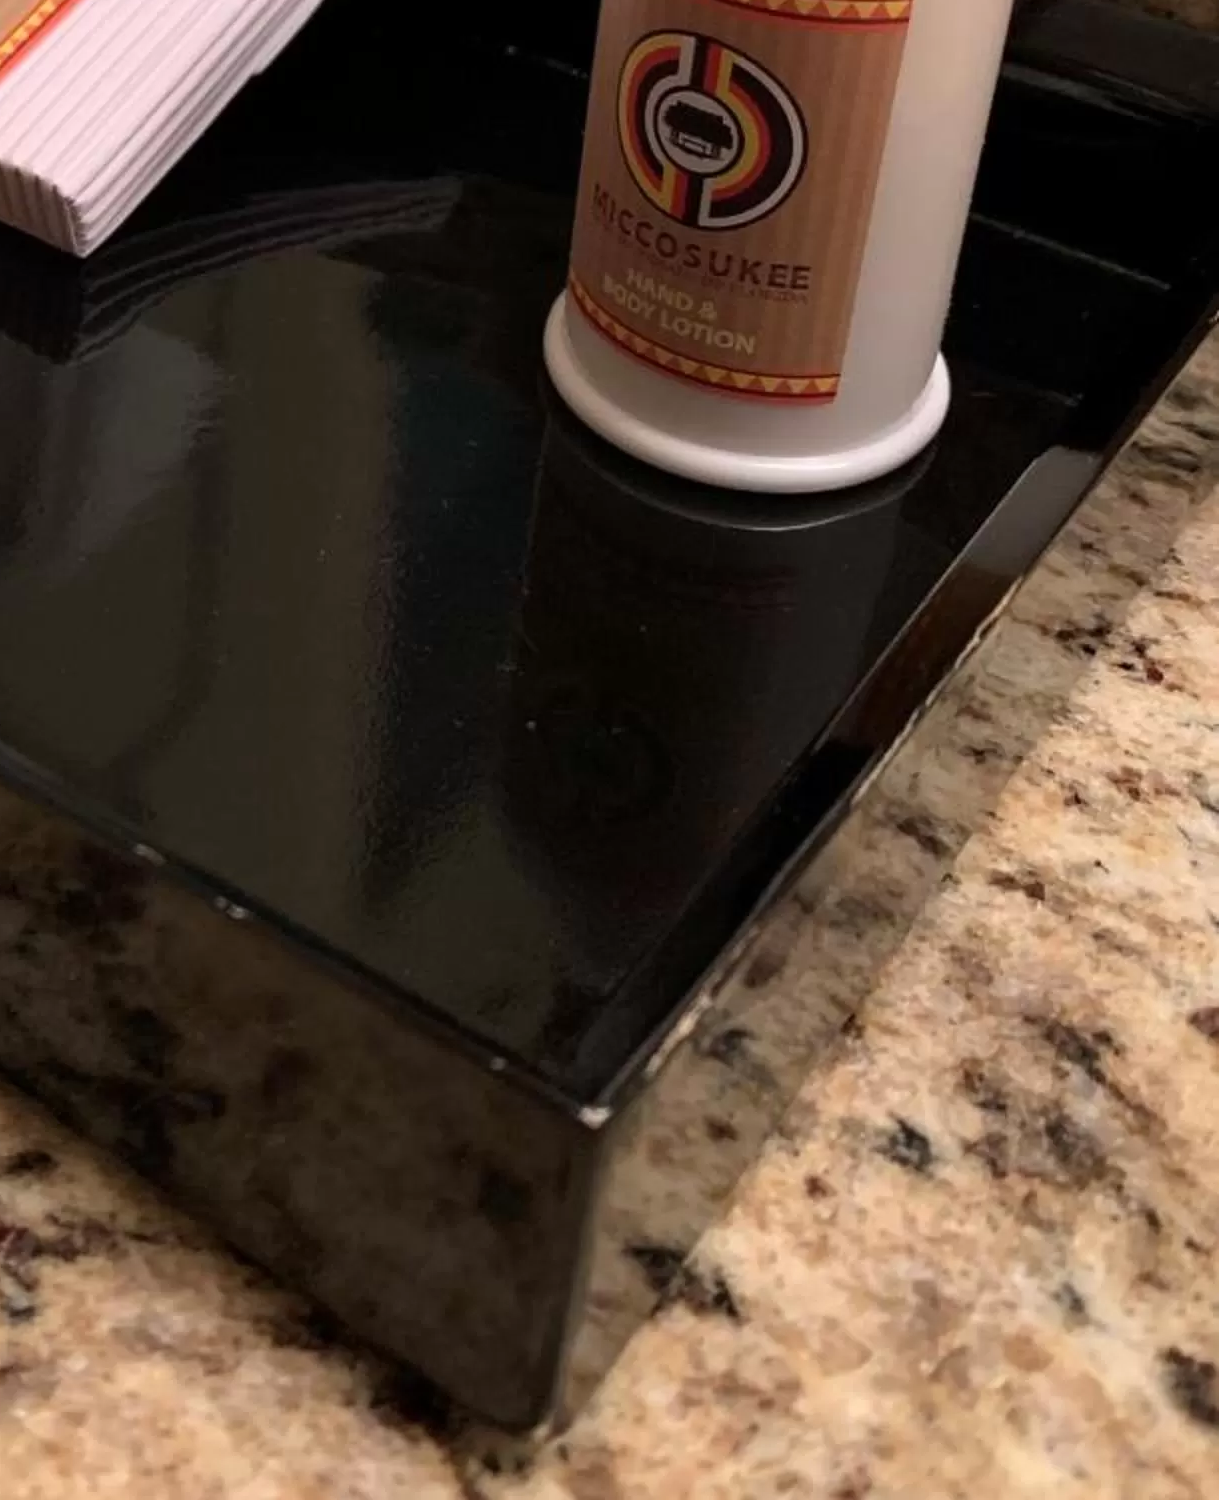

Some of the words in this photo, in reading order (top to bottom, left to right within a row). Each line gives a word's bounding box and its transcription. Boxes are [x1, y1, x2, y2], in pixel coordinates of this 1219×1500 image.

[592, 183, 811, 290] MICCOSUKEE
[602, 275, 658, 321] BODY
[661, 313, 755, 354] LOTION
[626, 267, 694, 312] HAND
[698, 299, 718, 322] &
